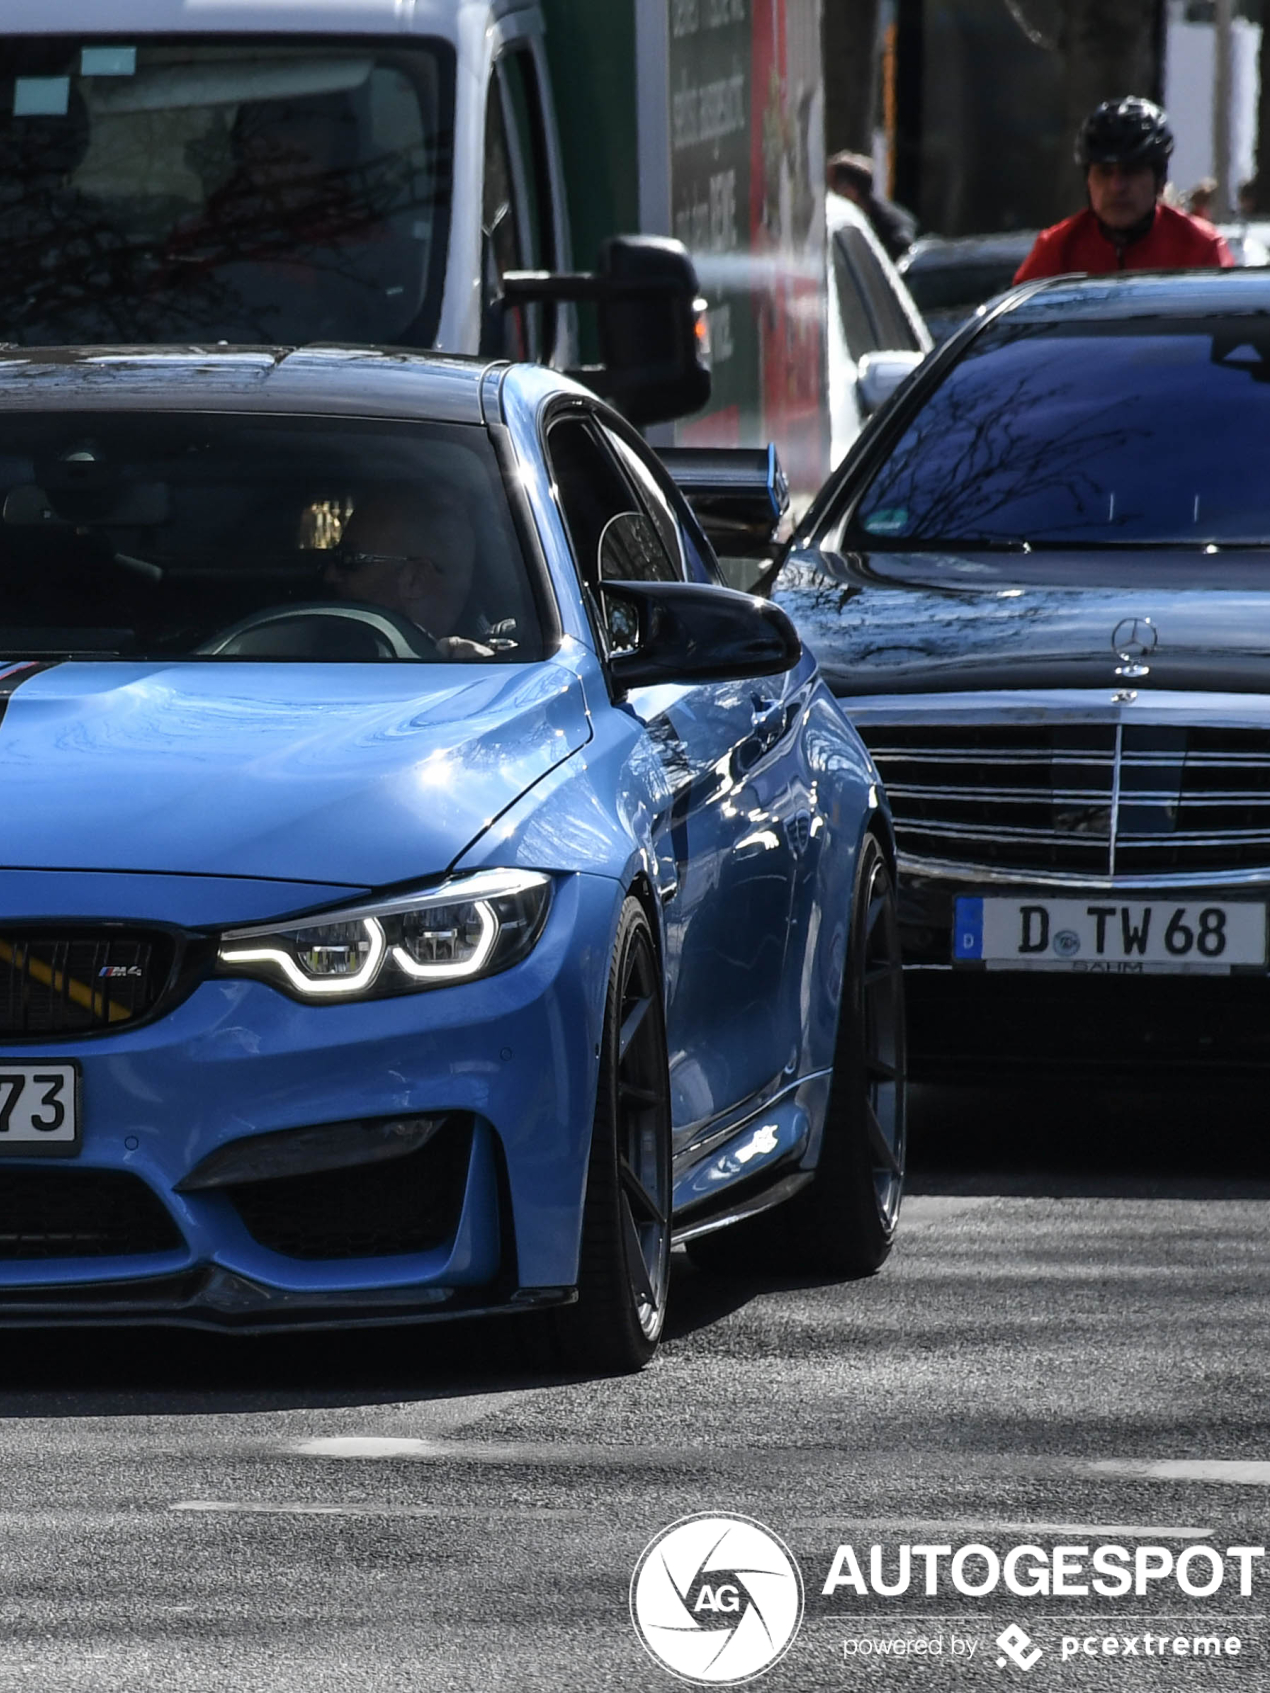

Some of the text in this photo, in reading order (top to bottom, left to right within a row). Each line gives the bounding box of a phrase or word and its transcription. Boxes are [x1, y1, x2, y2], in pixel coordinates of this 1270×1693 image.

[1018, 906, 1227, 957] D TW 68
[963, 934, 974, 949] D
[111, 966, 142, 977] M4
